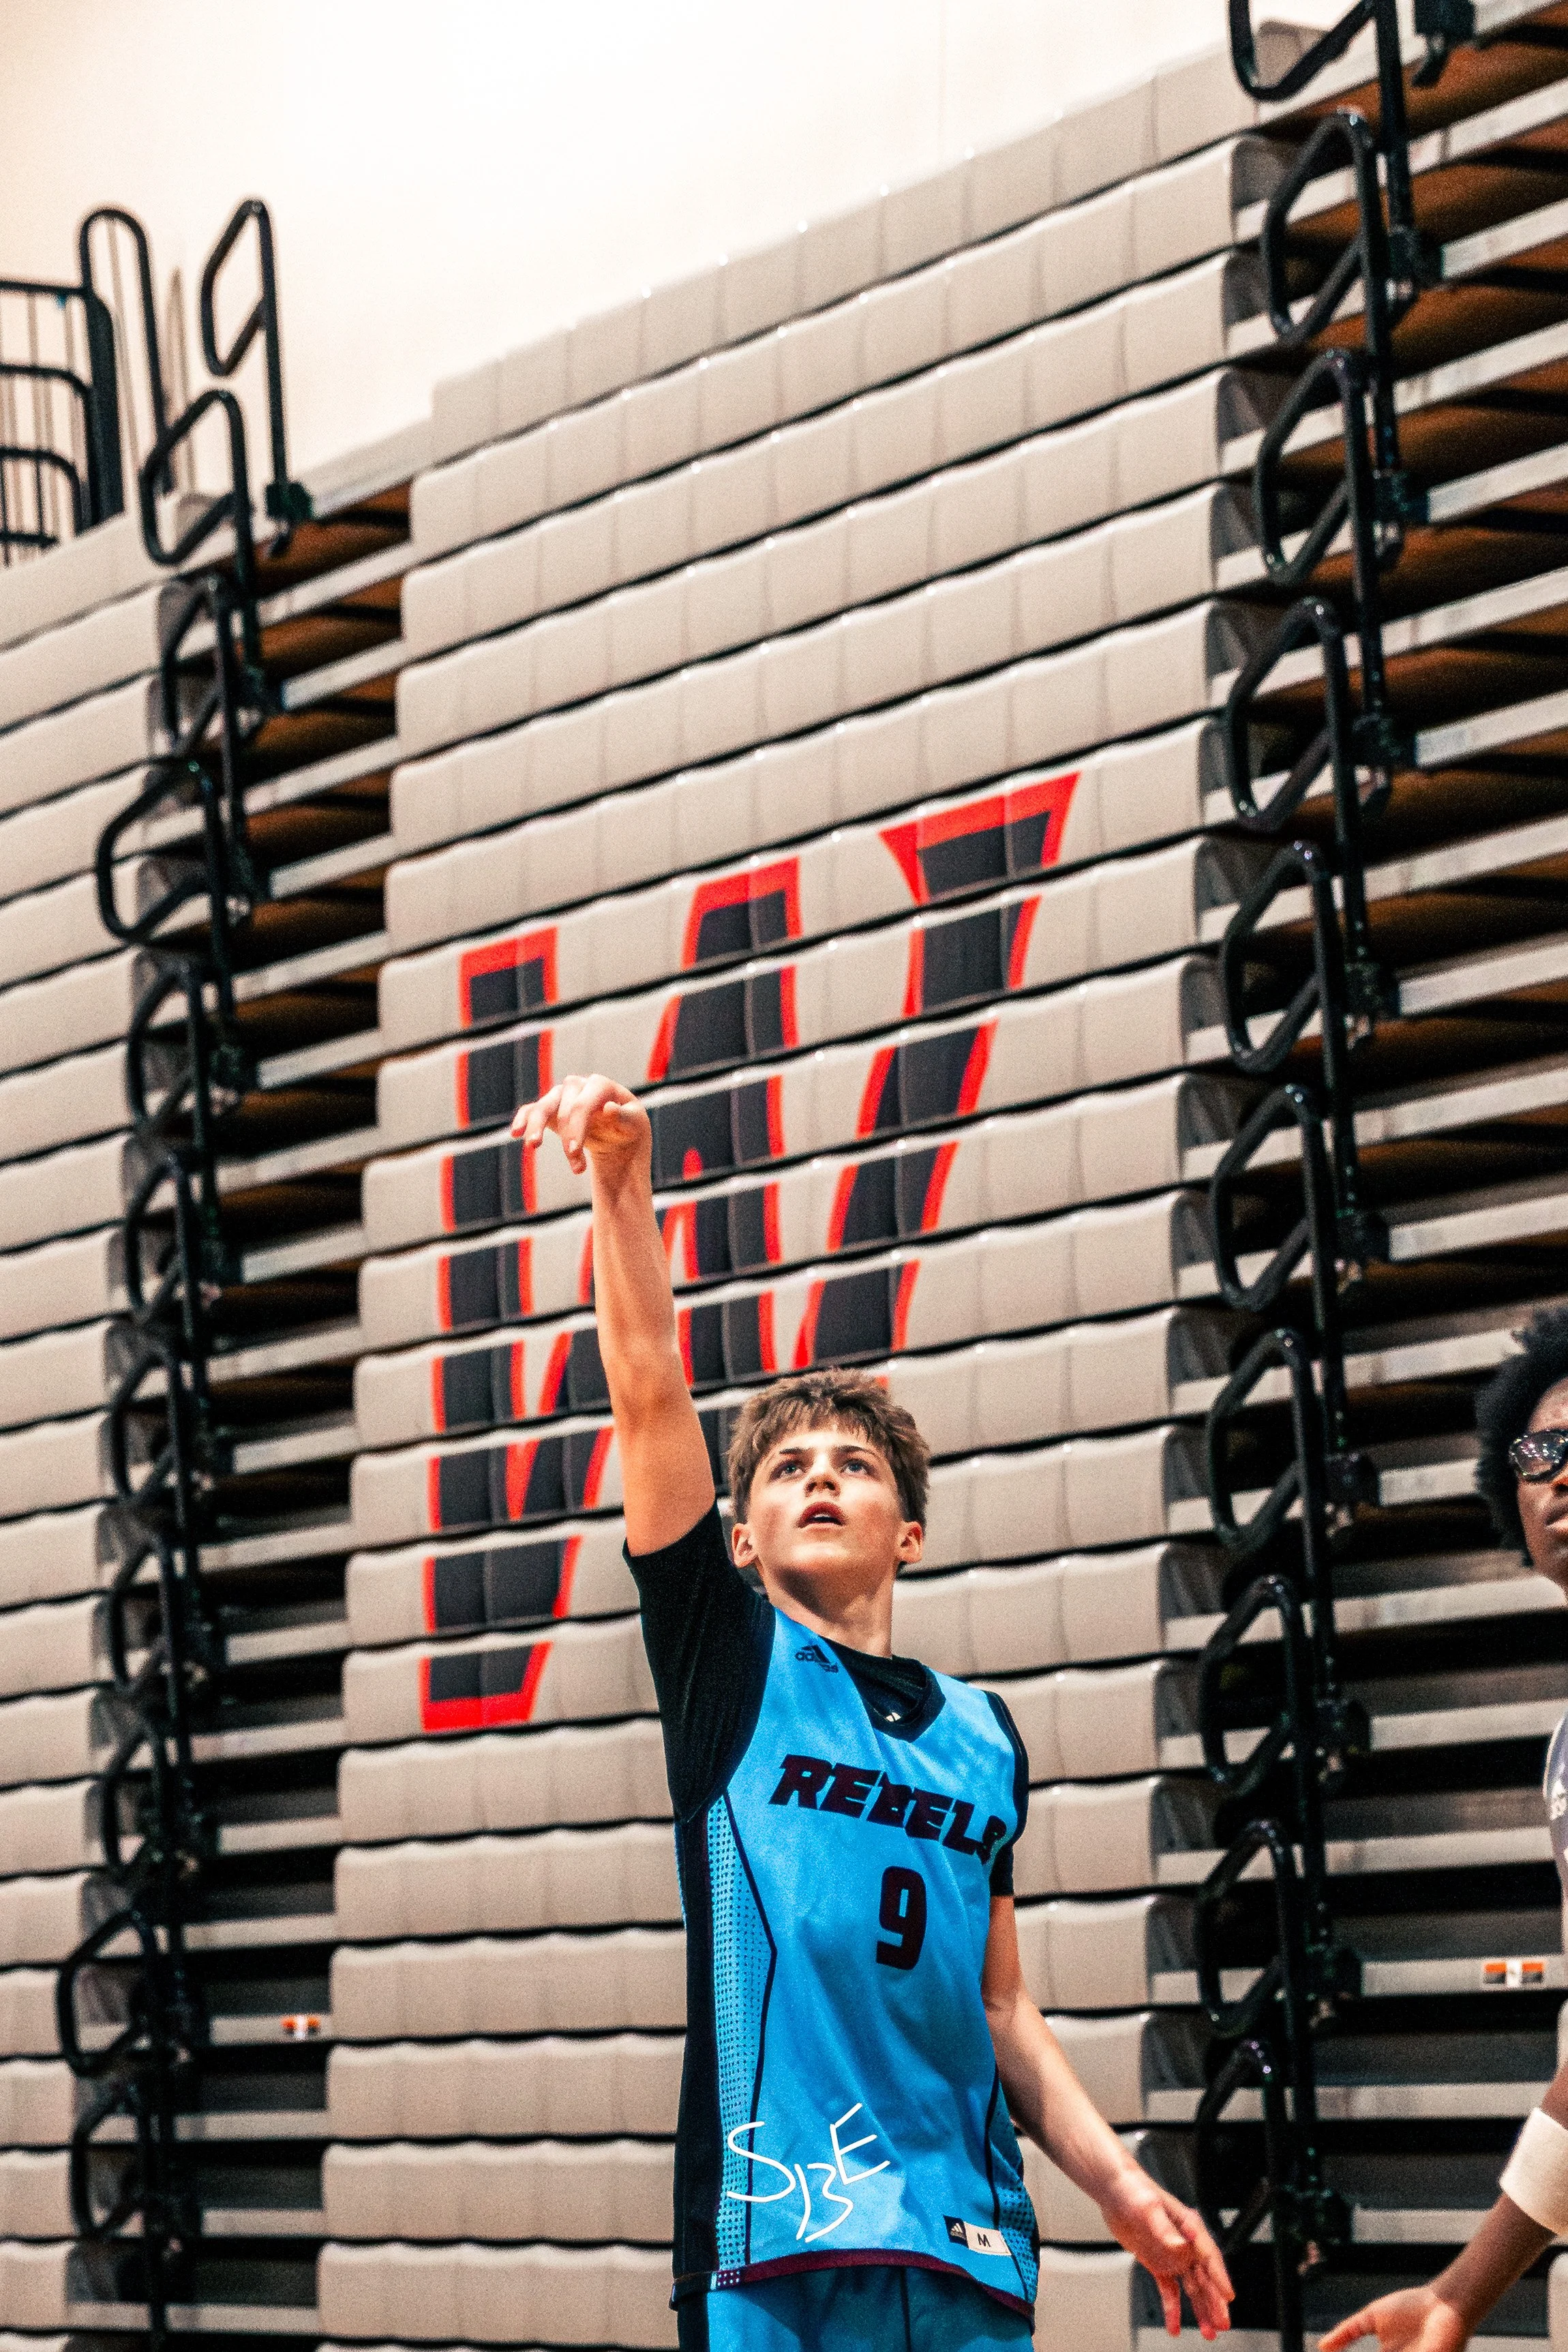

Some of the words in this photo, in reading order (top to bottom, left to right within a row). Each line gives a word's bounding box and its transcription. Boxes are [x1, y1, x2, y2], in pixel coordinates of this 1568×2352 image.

[794, 1651, 839, 1674] adas
[875, 1865, 927, 1971] 9
[977, 2232, 991, 2248] M
